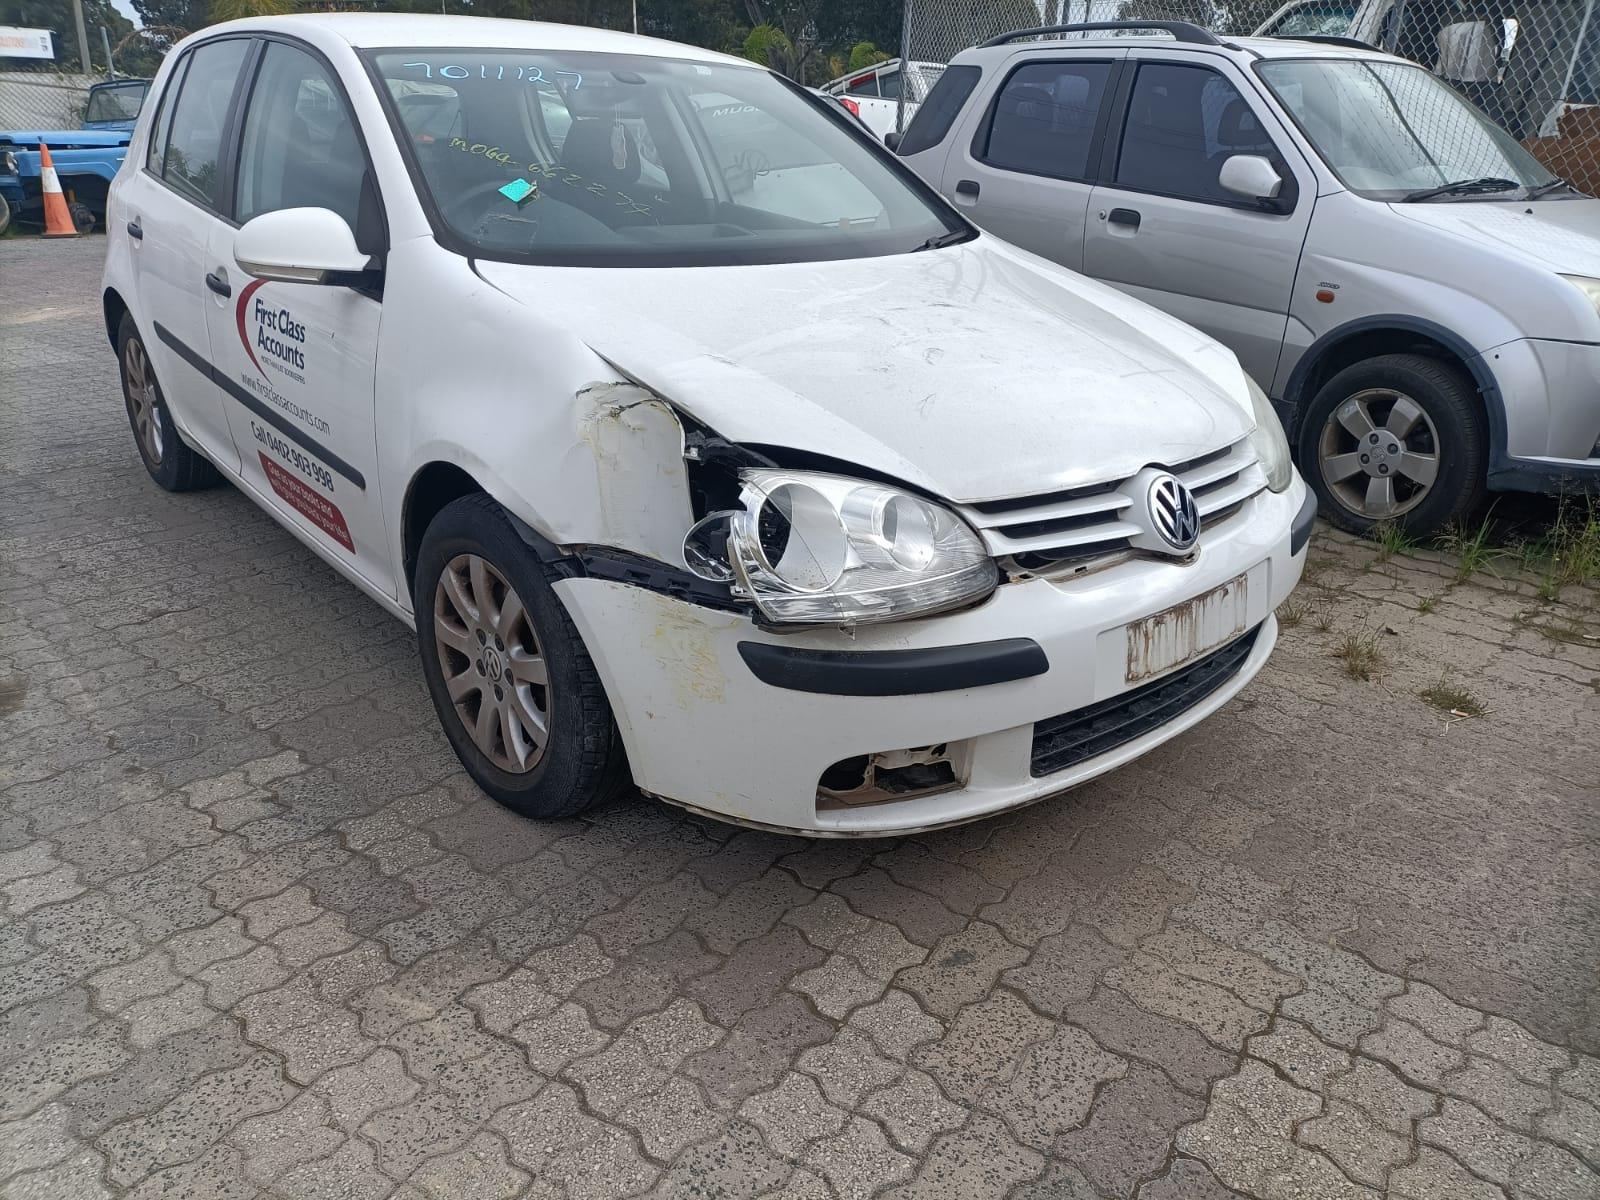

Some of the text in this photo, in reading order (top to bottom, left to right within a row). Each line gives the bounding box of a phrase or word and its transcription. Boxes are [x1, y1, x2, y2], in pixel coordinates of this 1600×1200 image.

[403, 62, 582, 90] 7011127
[255, 298, 306, 343] First Class
[257, 325, 305, 370] Accounts
[250, 420, 268, 446] Call
[266, 431, 293, 463] 0402
[290, 448, 312, 478] 903
[312, 462, 334, 492] 998
